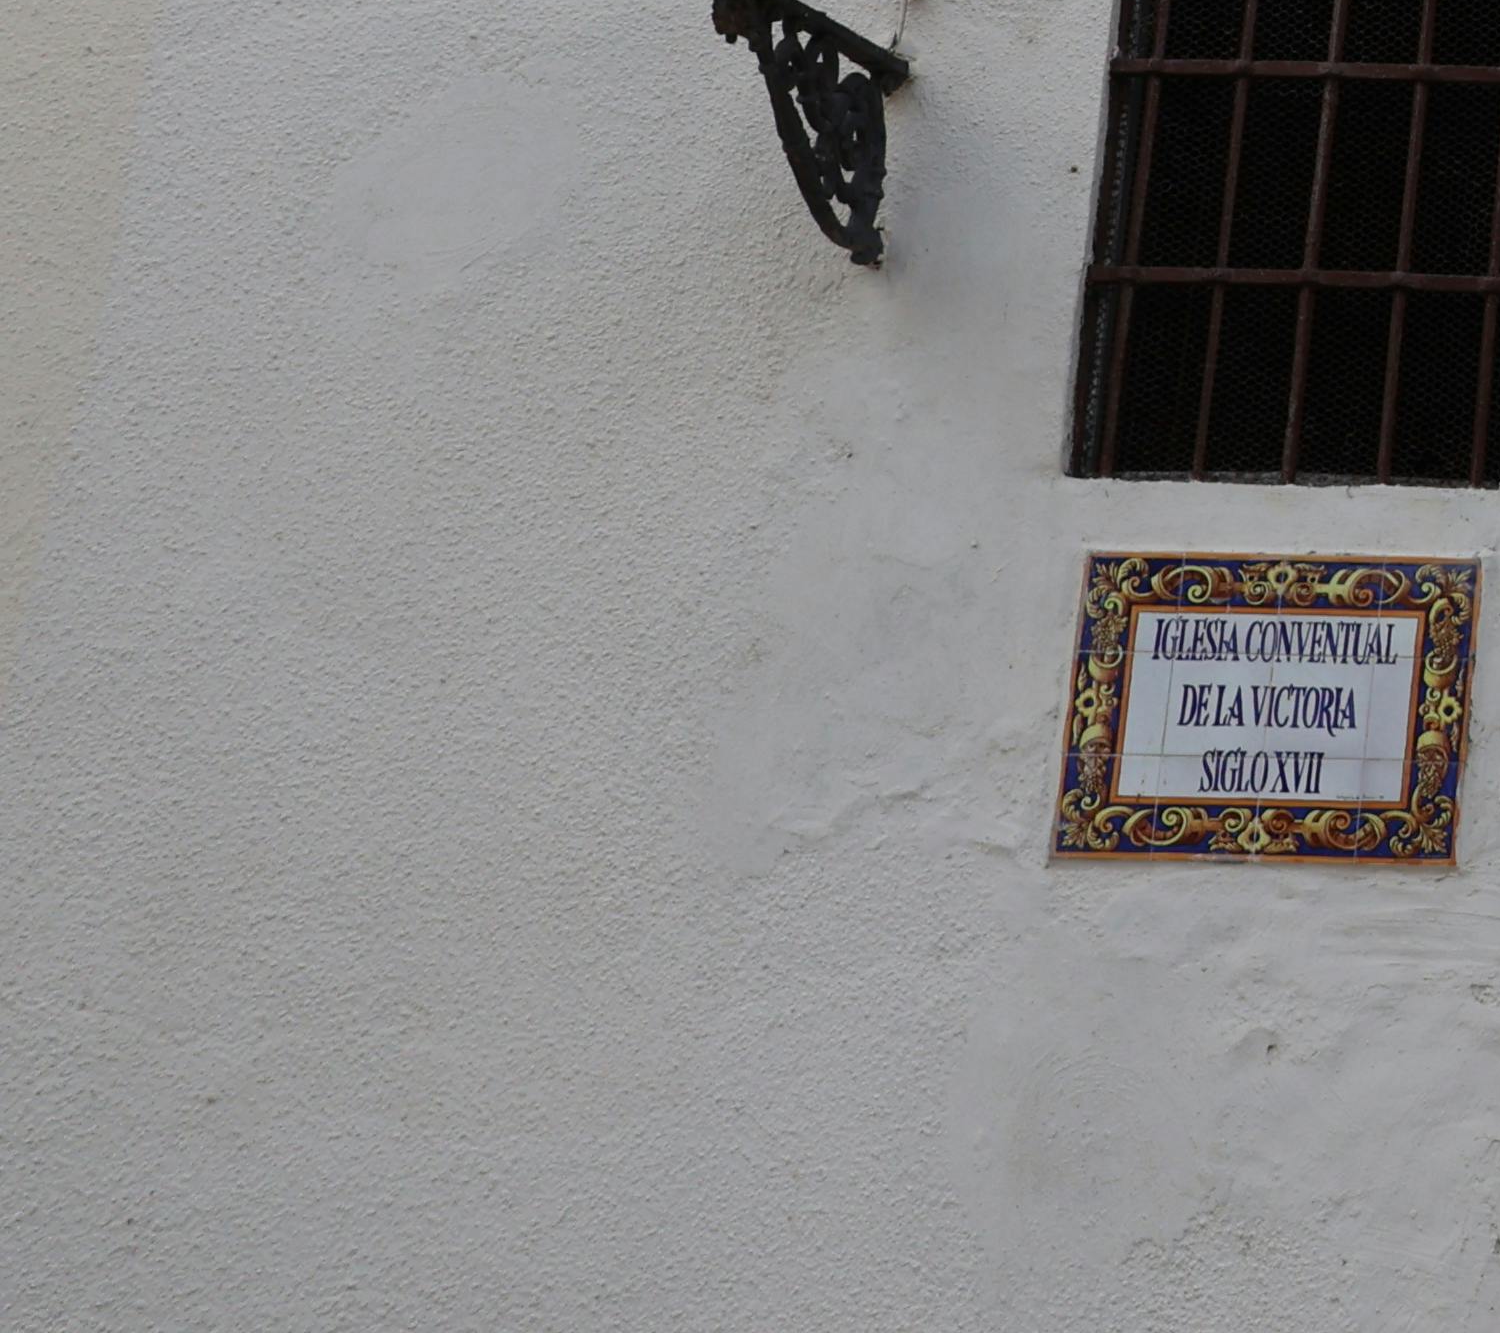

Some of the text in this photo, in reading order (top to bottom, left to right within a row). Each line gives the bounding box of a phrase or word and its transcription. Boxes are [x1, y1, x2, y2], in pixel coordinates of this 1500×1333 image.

[1152, 618, 1398, 666] IGLESIA CONVENTUAL
[1177, 684, 1357, 737] DE LA VICTORIA
[1198, 747, 1324, 794] SIGLO XVII
